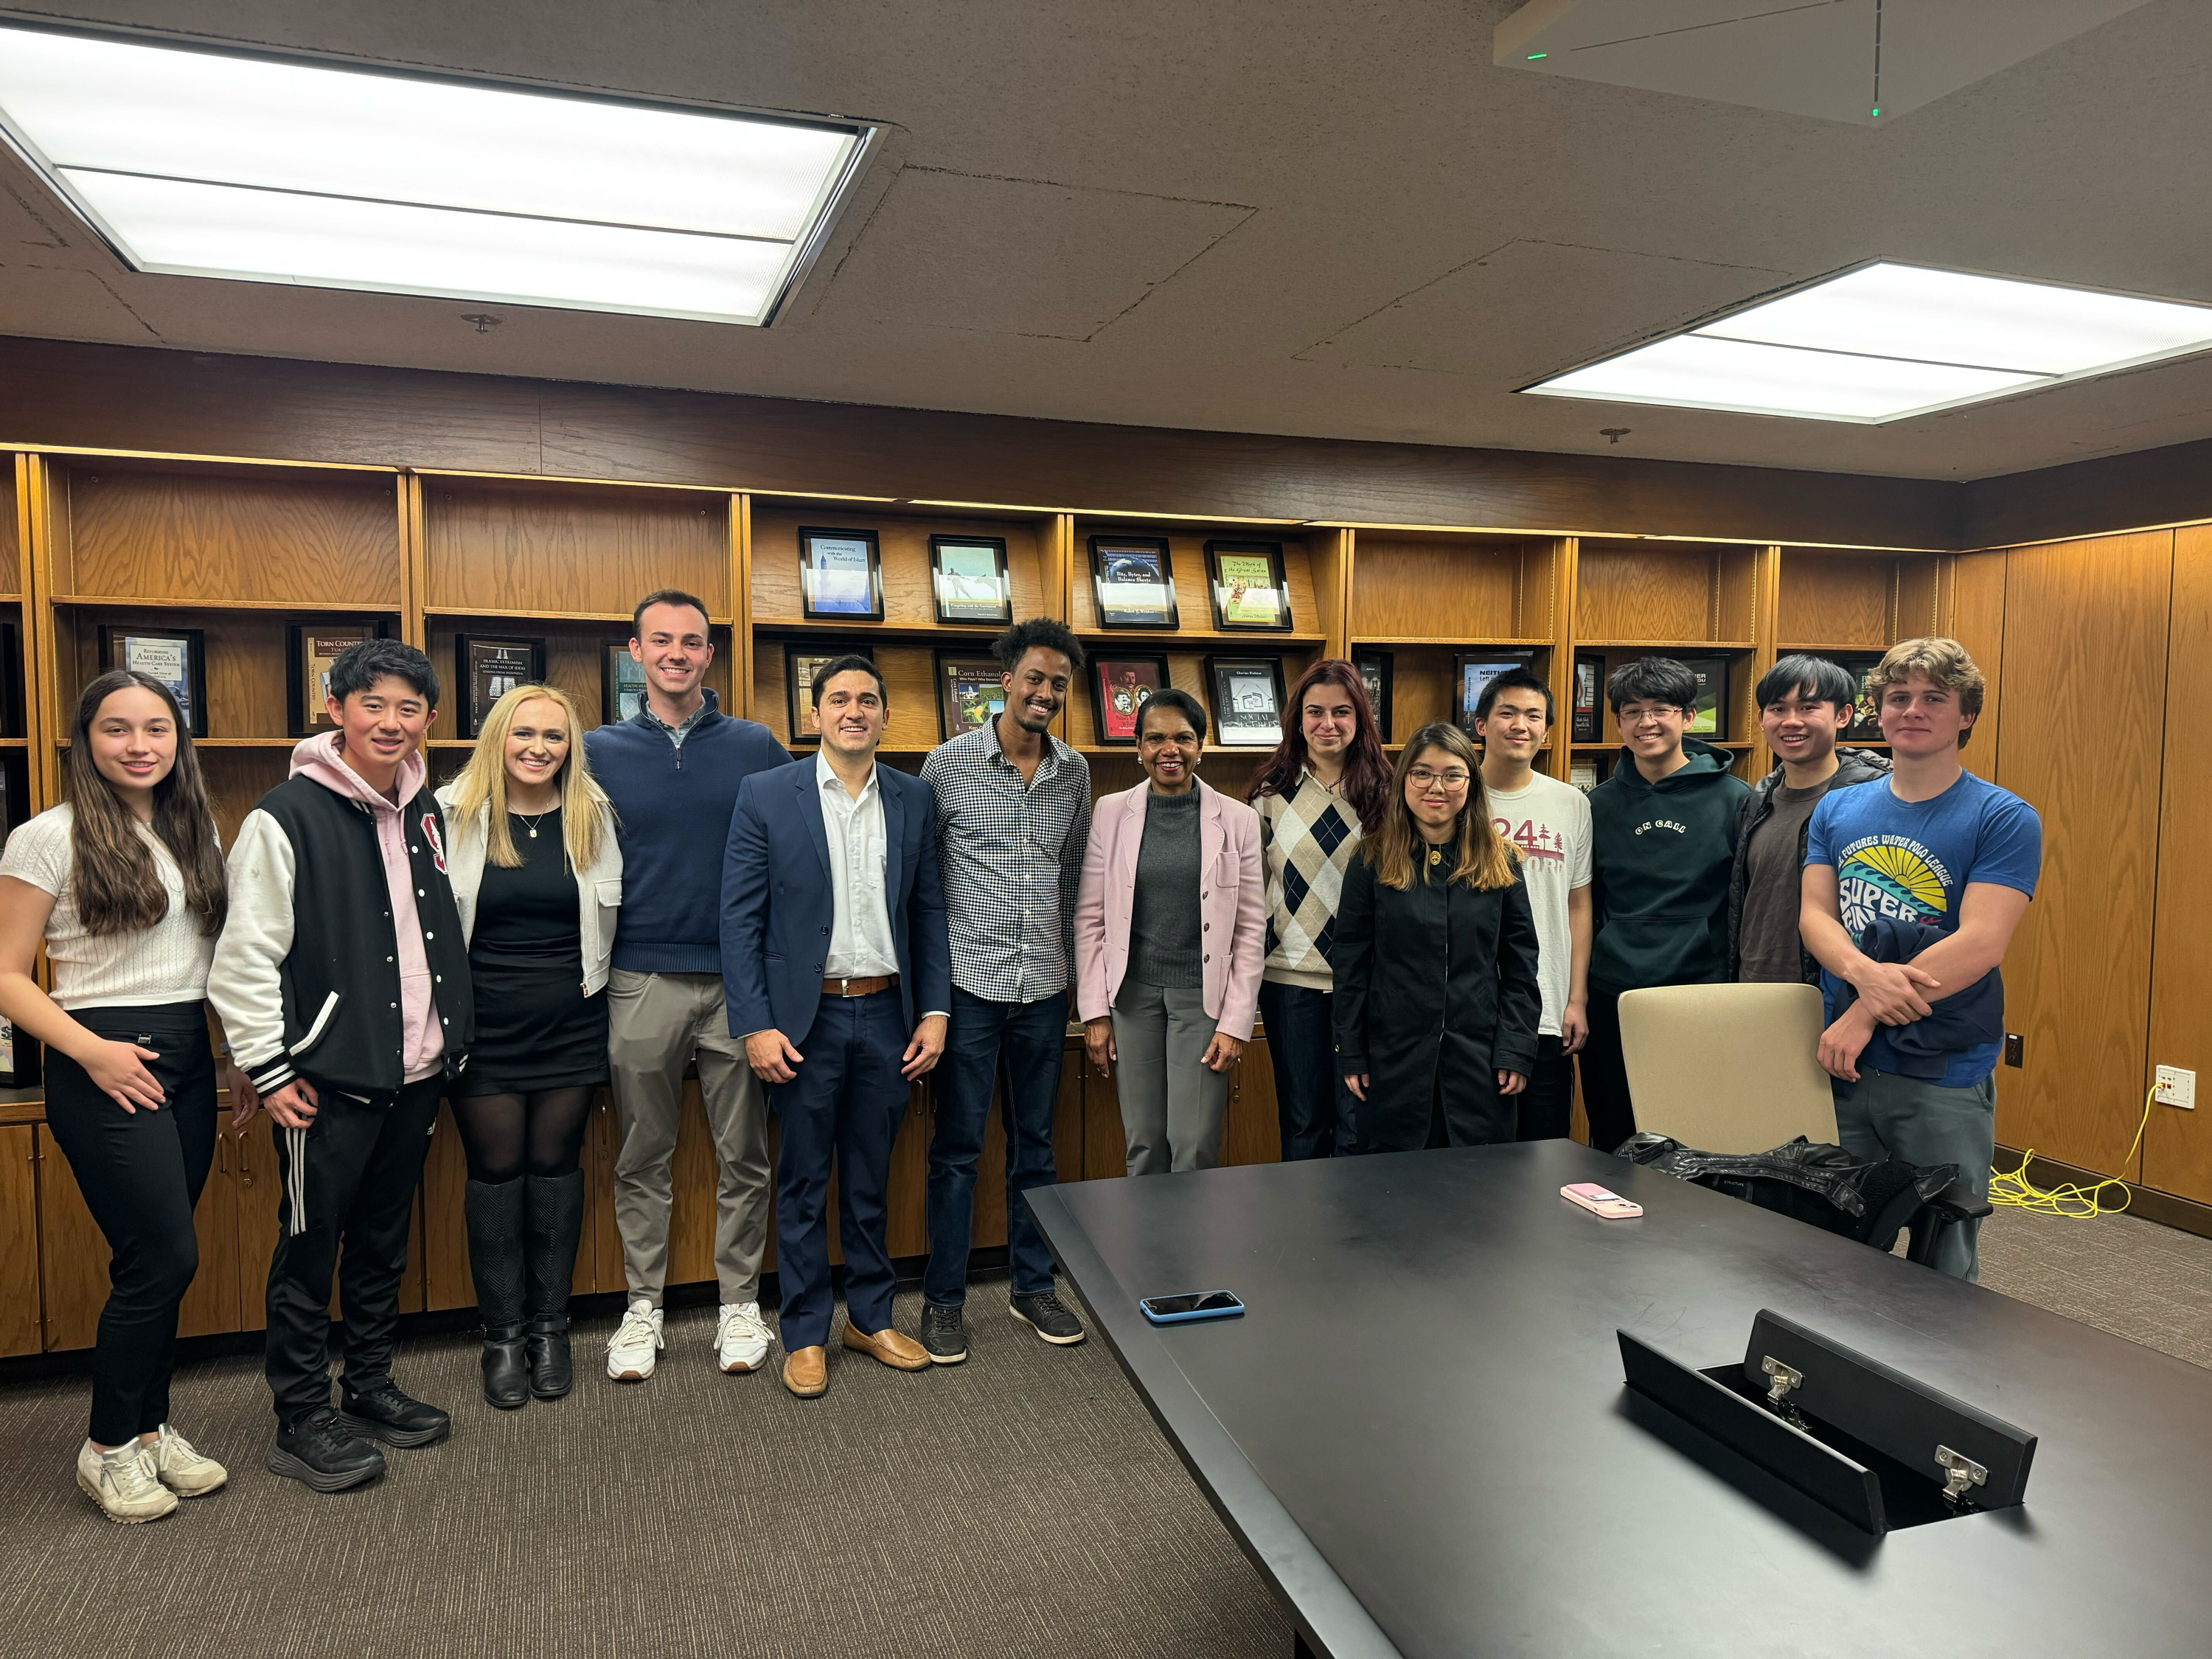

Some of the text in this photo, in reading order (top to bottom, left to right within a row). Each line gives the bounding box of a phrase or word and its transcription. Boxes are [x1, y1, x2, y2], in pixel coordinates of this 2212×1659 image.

[136, 653, 176, 661] AMERICA'S
[1489, 818, 1537, 846] 24
[1635, 820, 1686, 835] ON CALL
[1523, 856, 1564, 874] ORD
[1842, 835, 1879, 859] FUTURES
[1881, 835, 1910, 848] WATER
[1909, 840, 1929, 858] POLO
[1924, 854, 1953, 887] LEAGUE
[1840, 878, 1918, 922] SUPER
[1841, 905, 1877, 935] FIN
